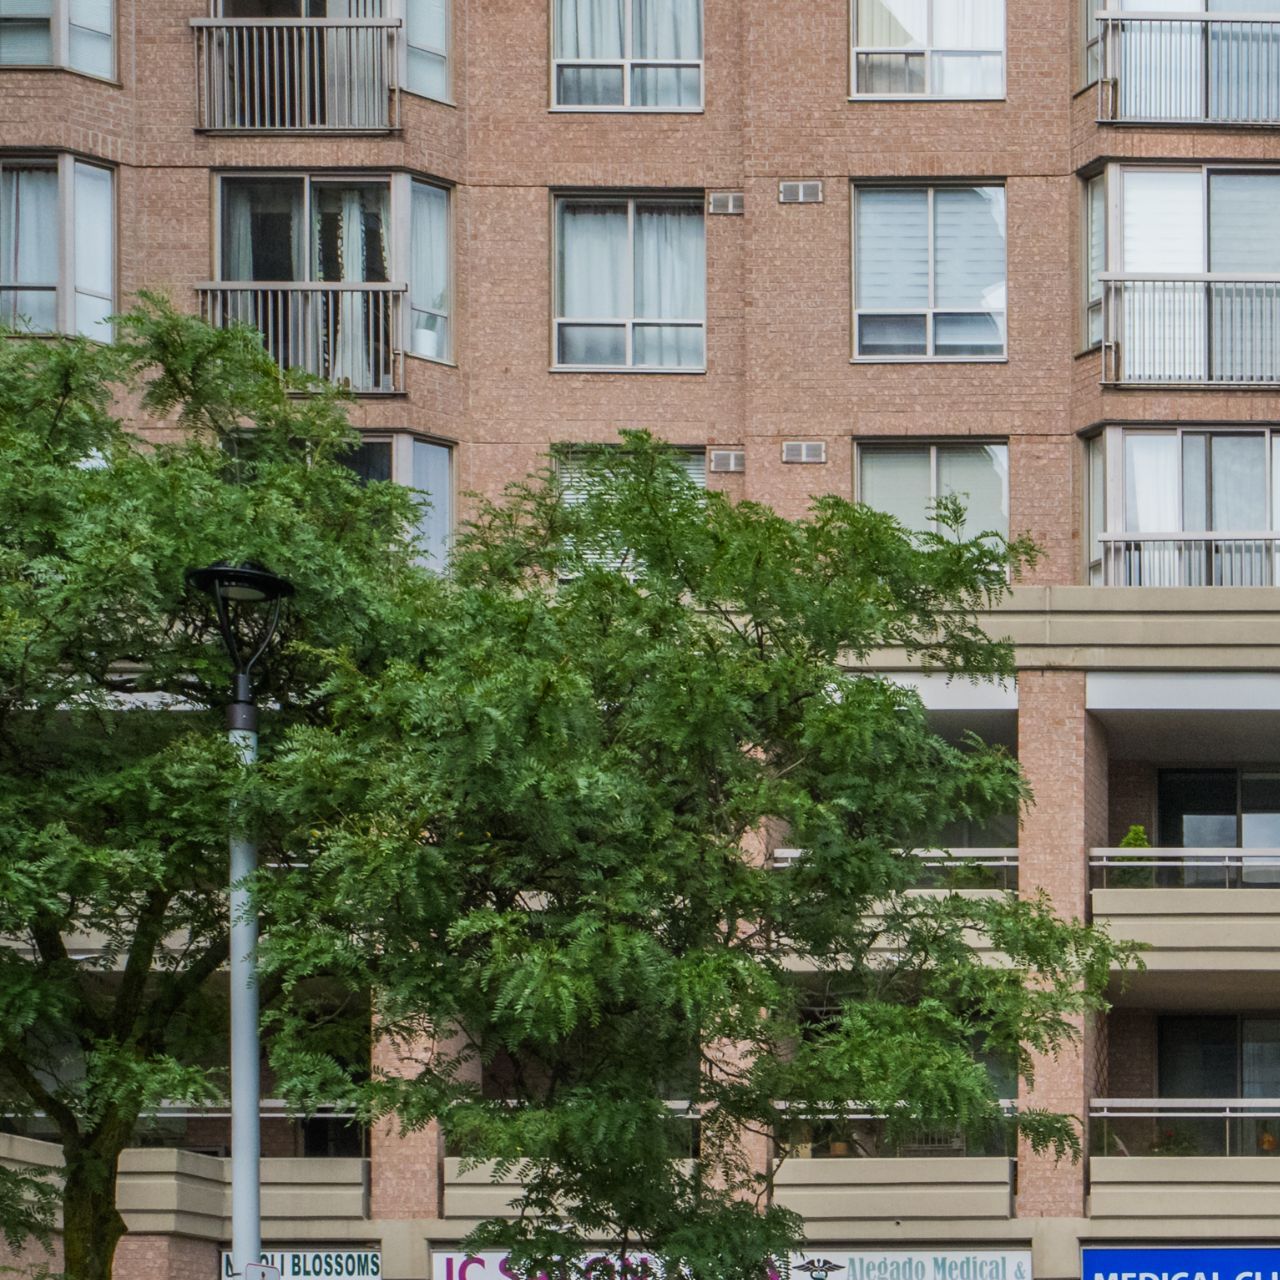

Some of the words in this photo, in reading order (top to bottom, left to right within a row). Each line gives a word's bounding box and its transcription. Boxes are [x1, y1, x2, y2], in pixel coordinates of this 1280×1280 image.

[291, 1253, 379, 1276] BLOSSOMS
[933, 1256, 1007, 1280] Medical
[1014, 1261, 1027, 1280] &
